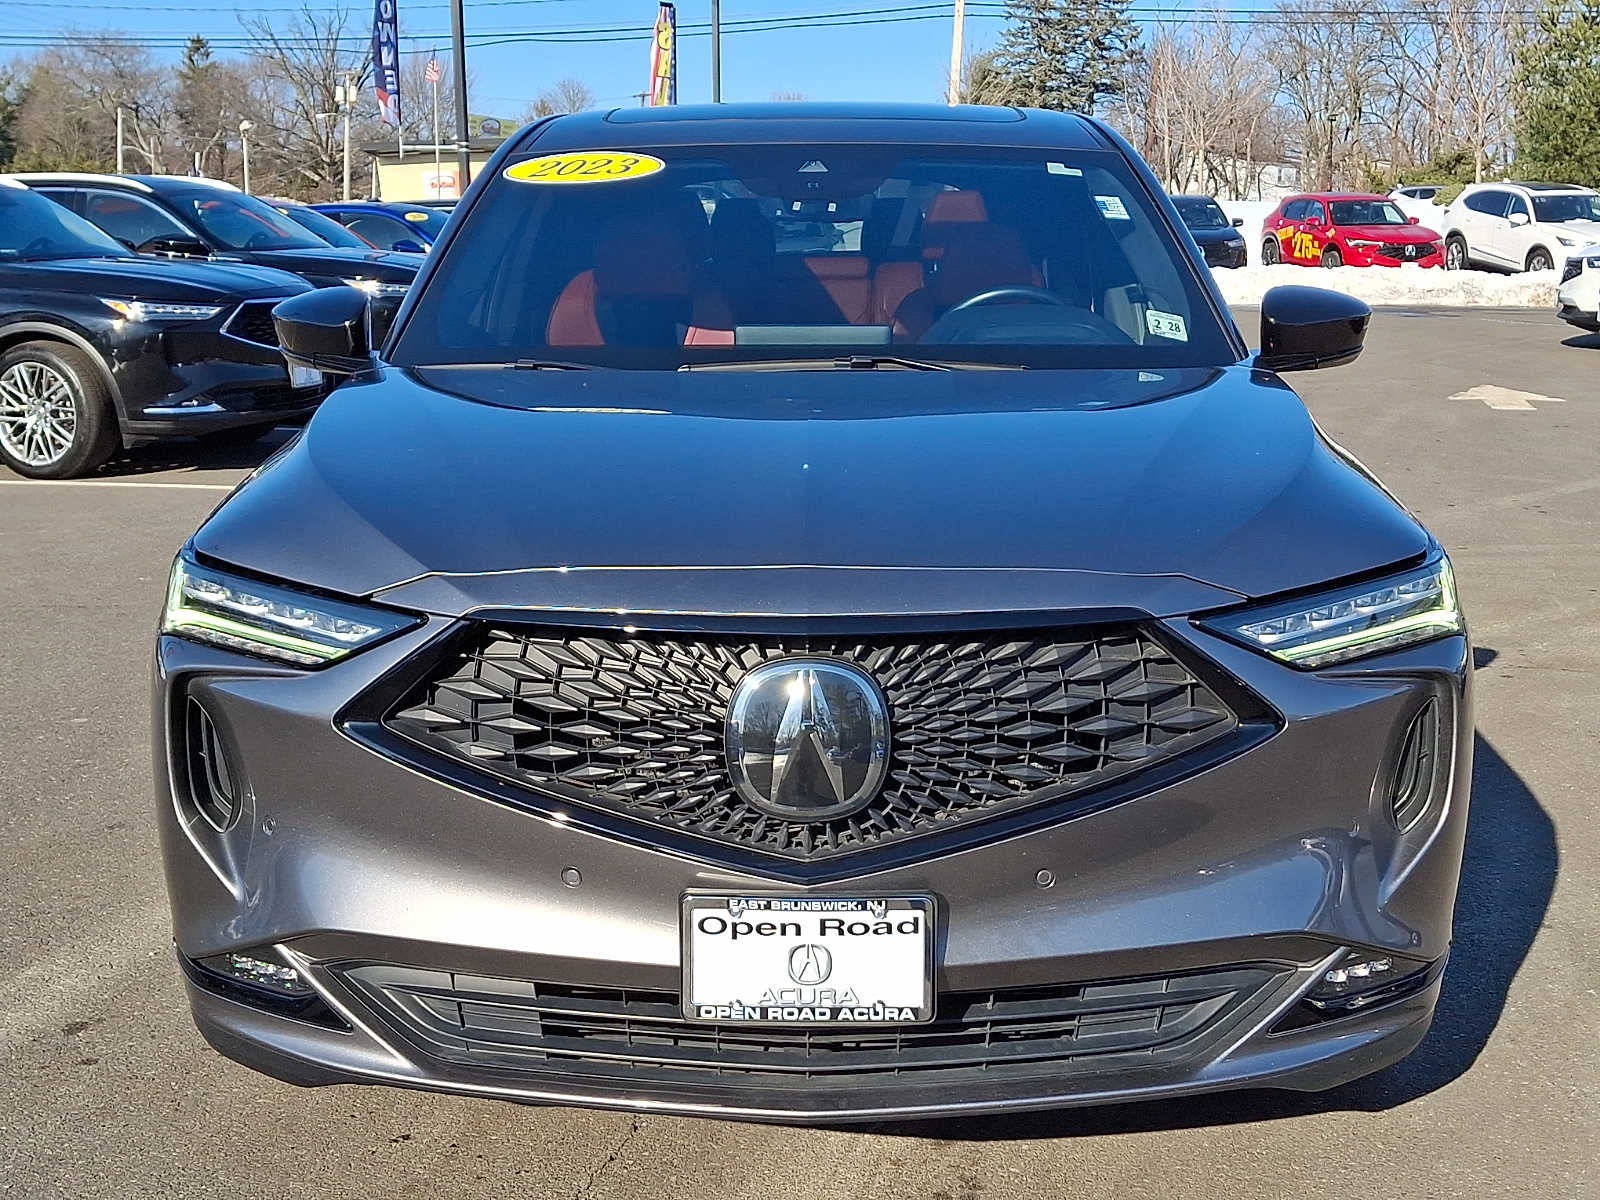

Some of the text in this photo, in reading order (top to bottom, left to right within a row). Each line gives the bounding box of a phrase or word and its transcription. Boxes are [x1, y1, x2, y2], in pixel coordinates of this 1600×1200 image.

[528, 157, 640, 178] 2023
[1153, 319, 1162, 329] 2
[1167, 321, 1181, 333] 28
[729, 900, 767, 911] EAST
[866, 900, 887, 911] NJ
[697, 916, 919, 940] Open Road
[759, 987, 860, 1005] ACURA
[699, 1005, 916, 1021] OPEN ROAD ACURA
